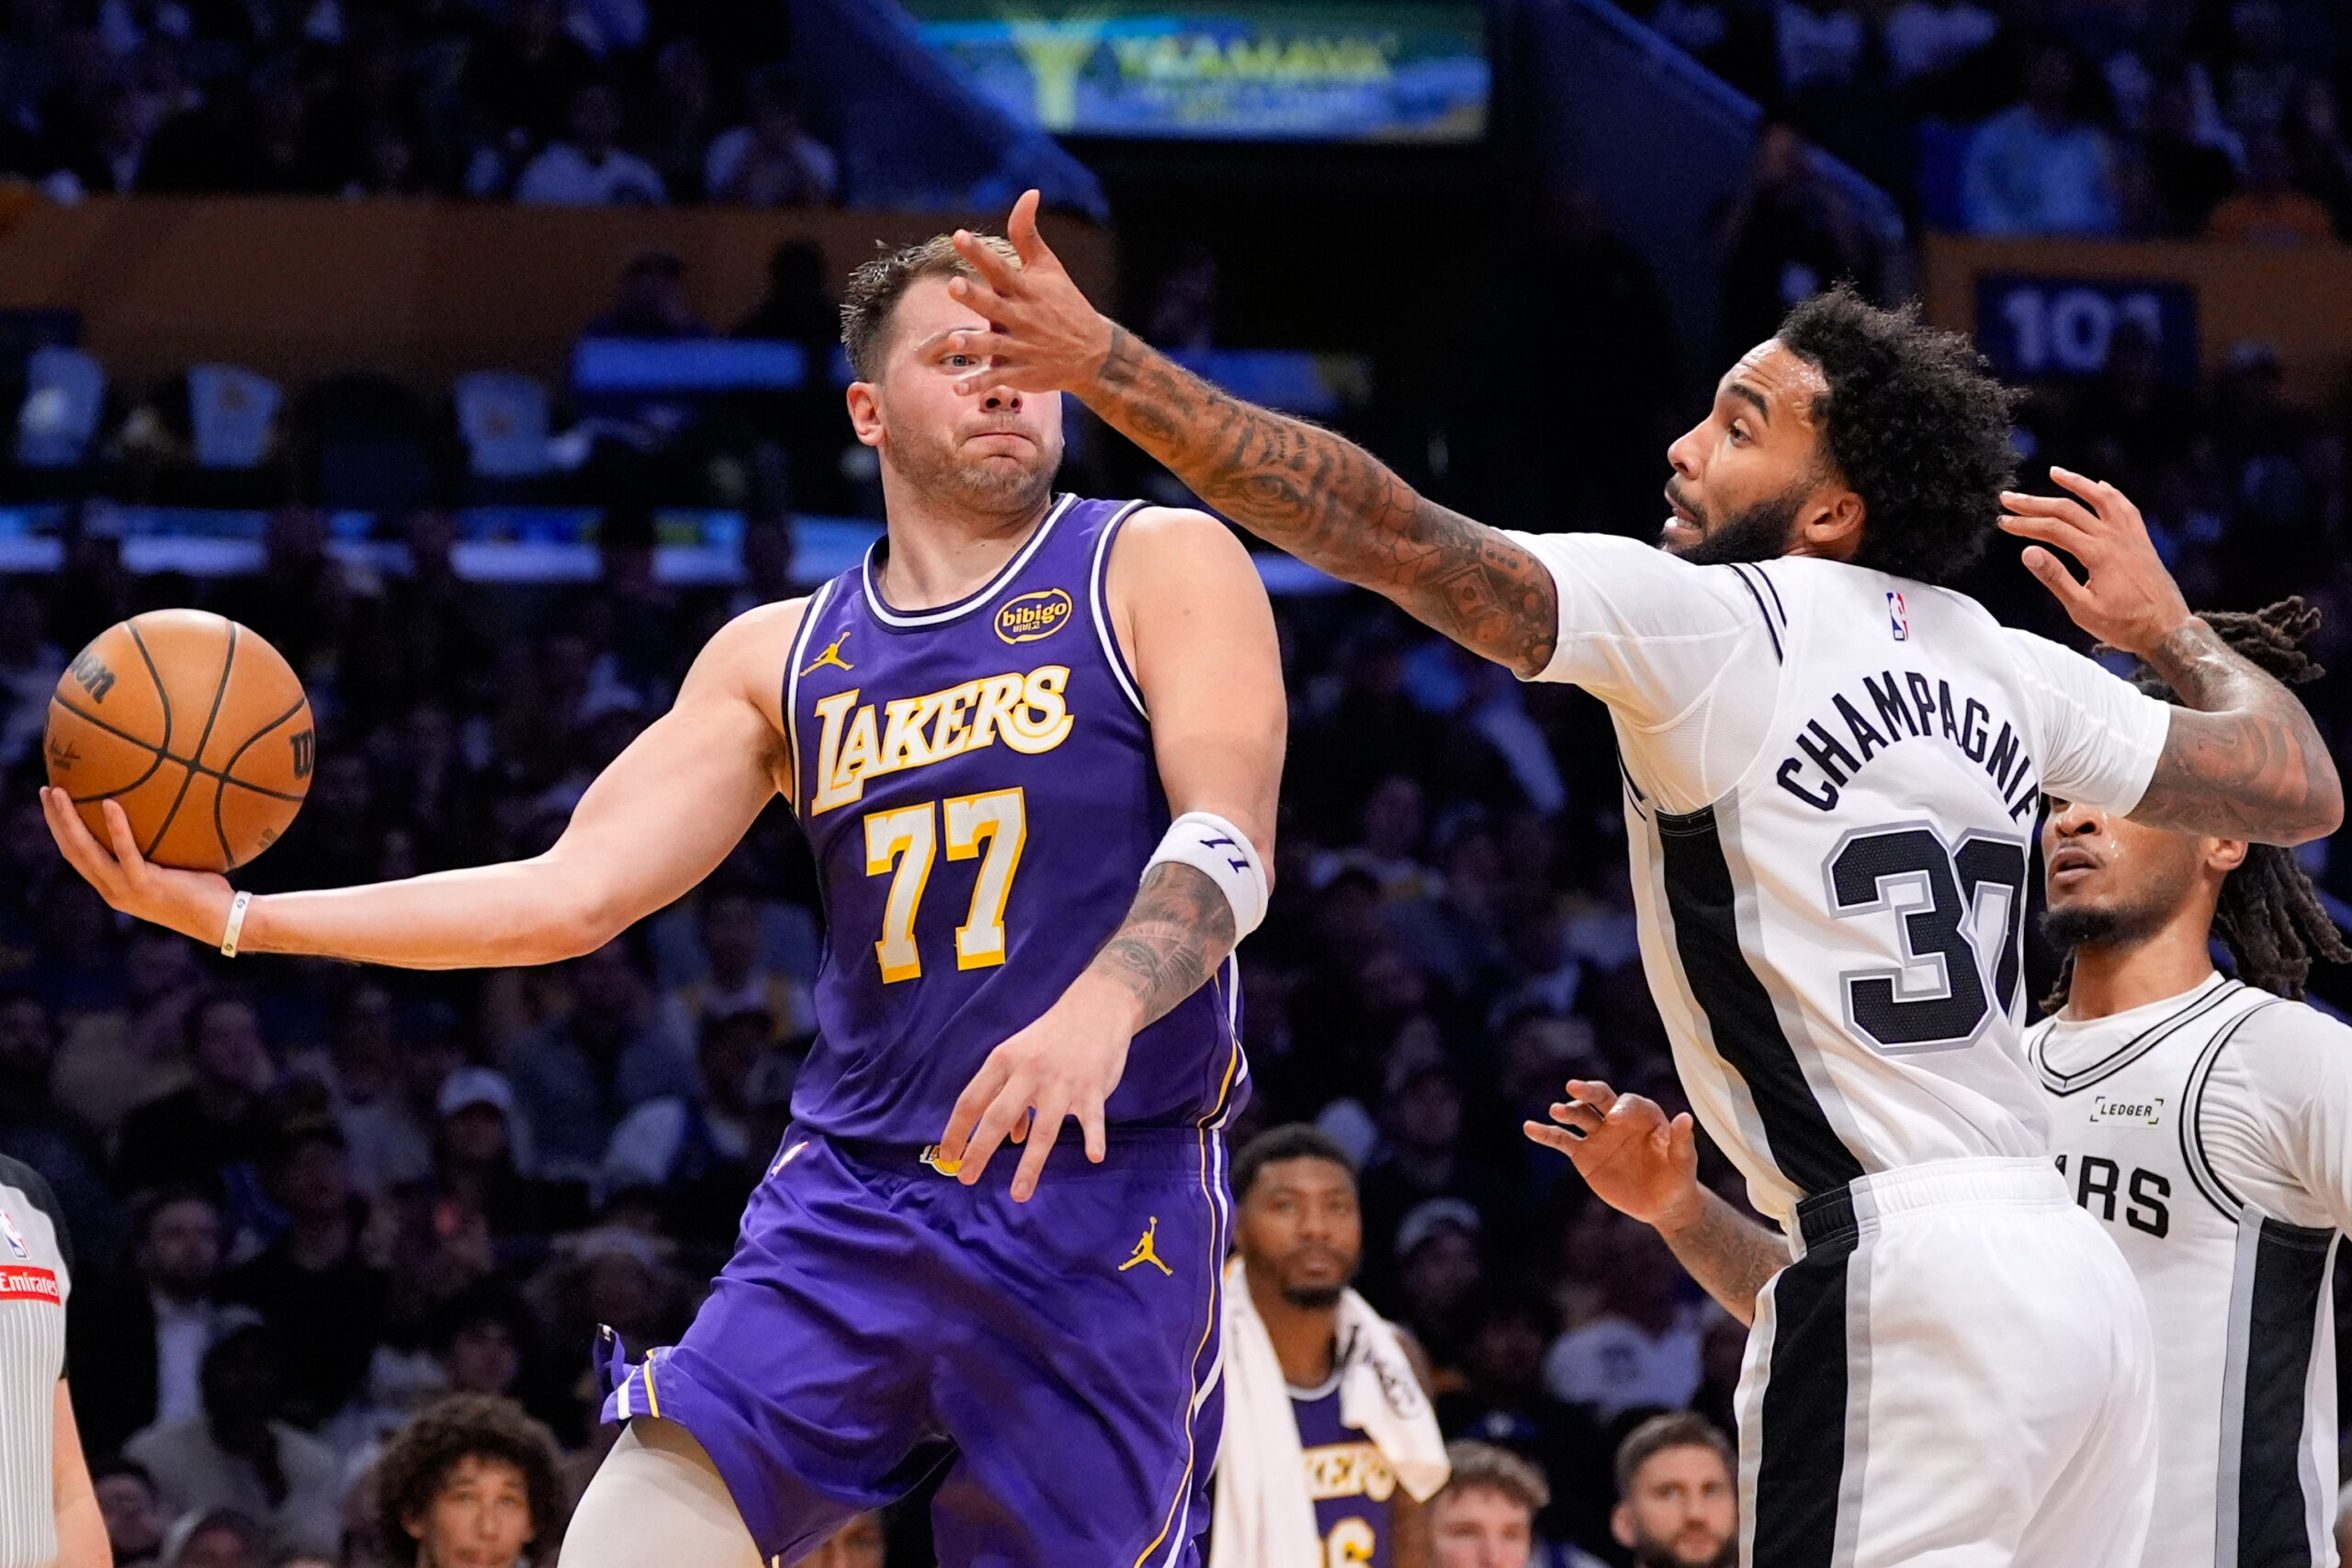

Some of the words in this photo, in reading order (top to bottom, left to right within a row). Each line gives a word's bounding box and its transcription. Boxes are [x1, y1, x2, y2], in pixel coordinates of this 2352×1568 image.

[1002, 603, 1068, 626] bibigo
[811, 665, 1075, 817] LAKERS
[1776, 670, 2040, 827] CHAMPAGNIE
[864, 786, 1027, 985] 77
[1821, 818, 2028, 1055] 30
[2100, 1103, 2153, 1118] LEDGER
[0, 1271, 59, 1296] Emirates
